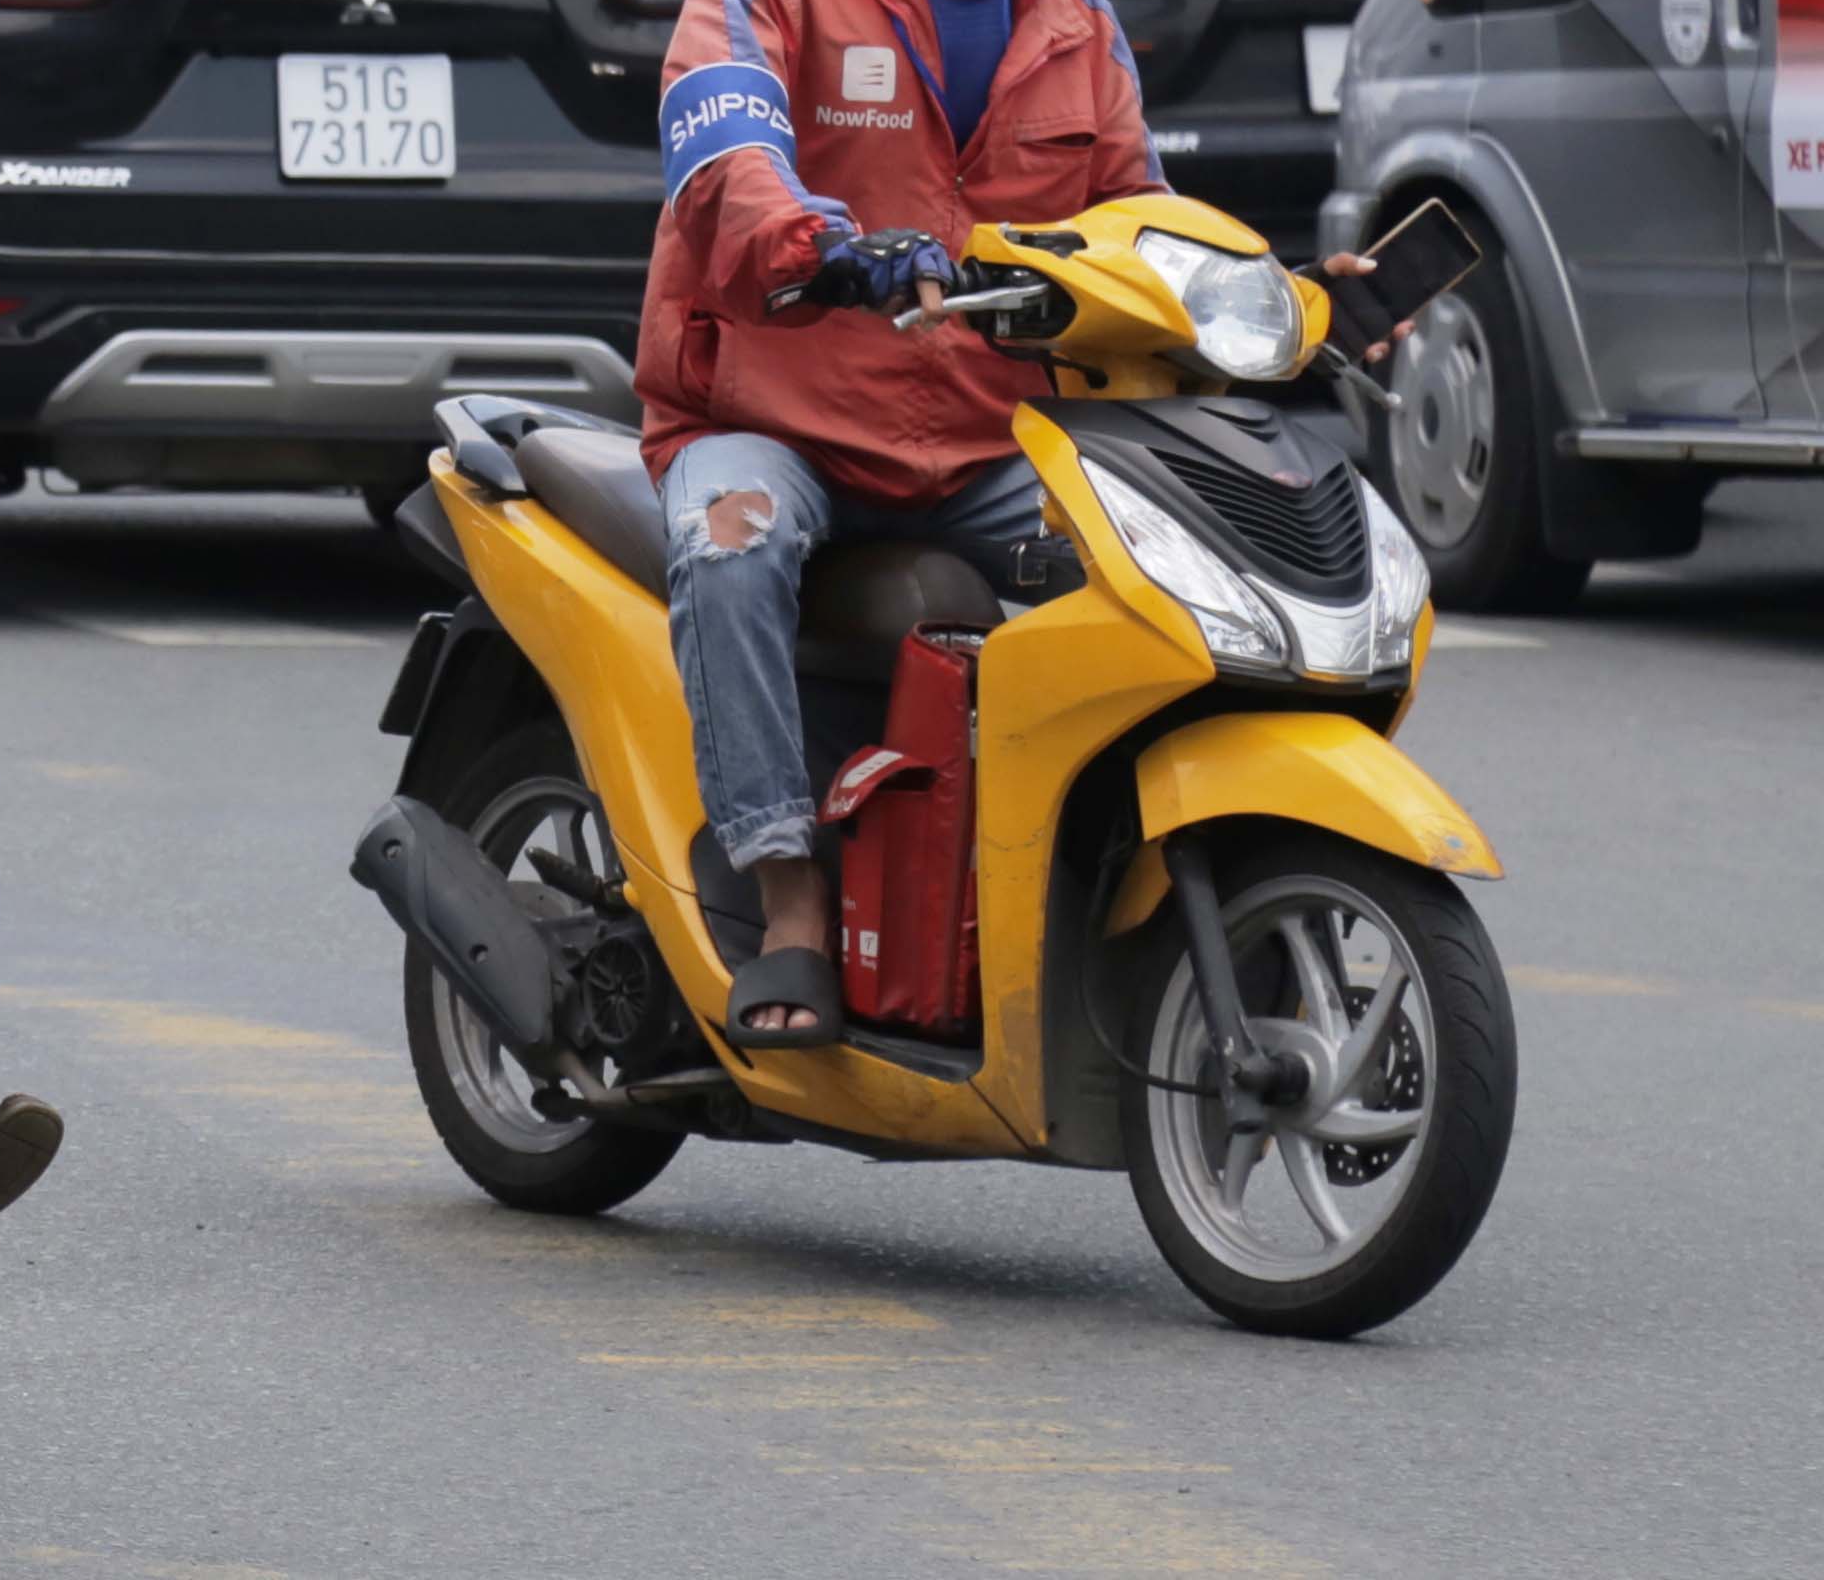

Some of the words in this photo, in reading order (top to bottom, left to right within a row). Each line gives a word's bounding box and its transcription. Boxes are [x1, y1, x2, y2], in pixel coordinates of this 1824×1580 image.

[321, 65, 408, 112] 51G
[815, 106, 914, 130] NowFood
[290, 121, 444, 170] 731.70
